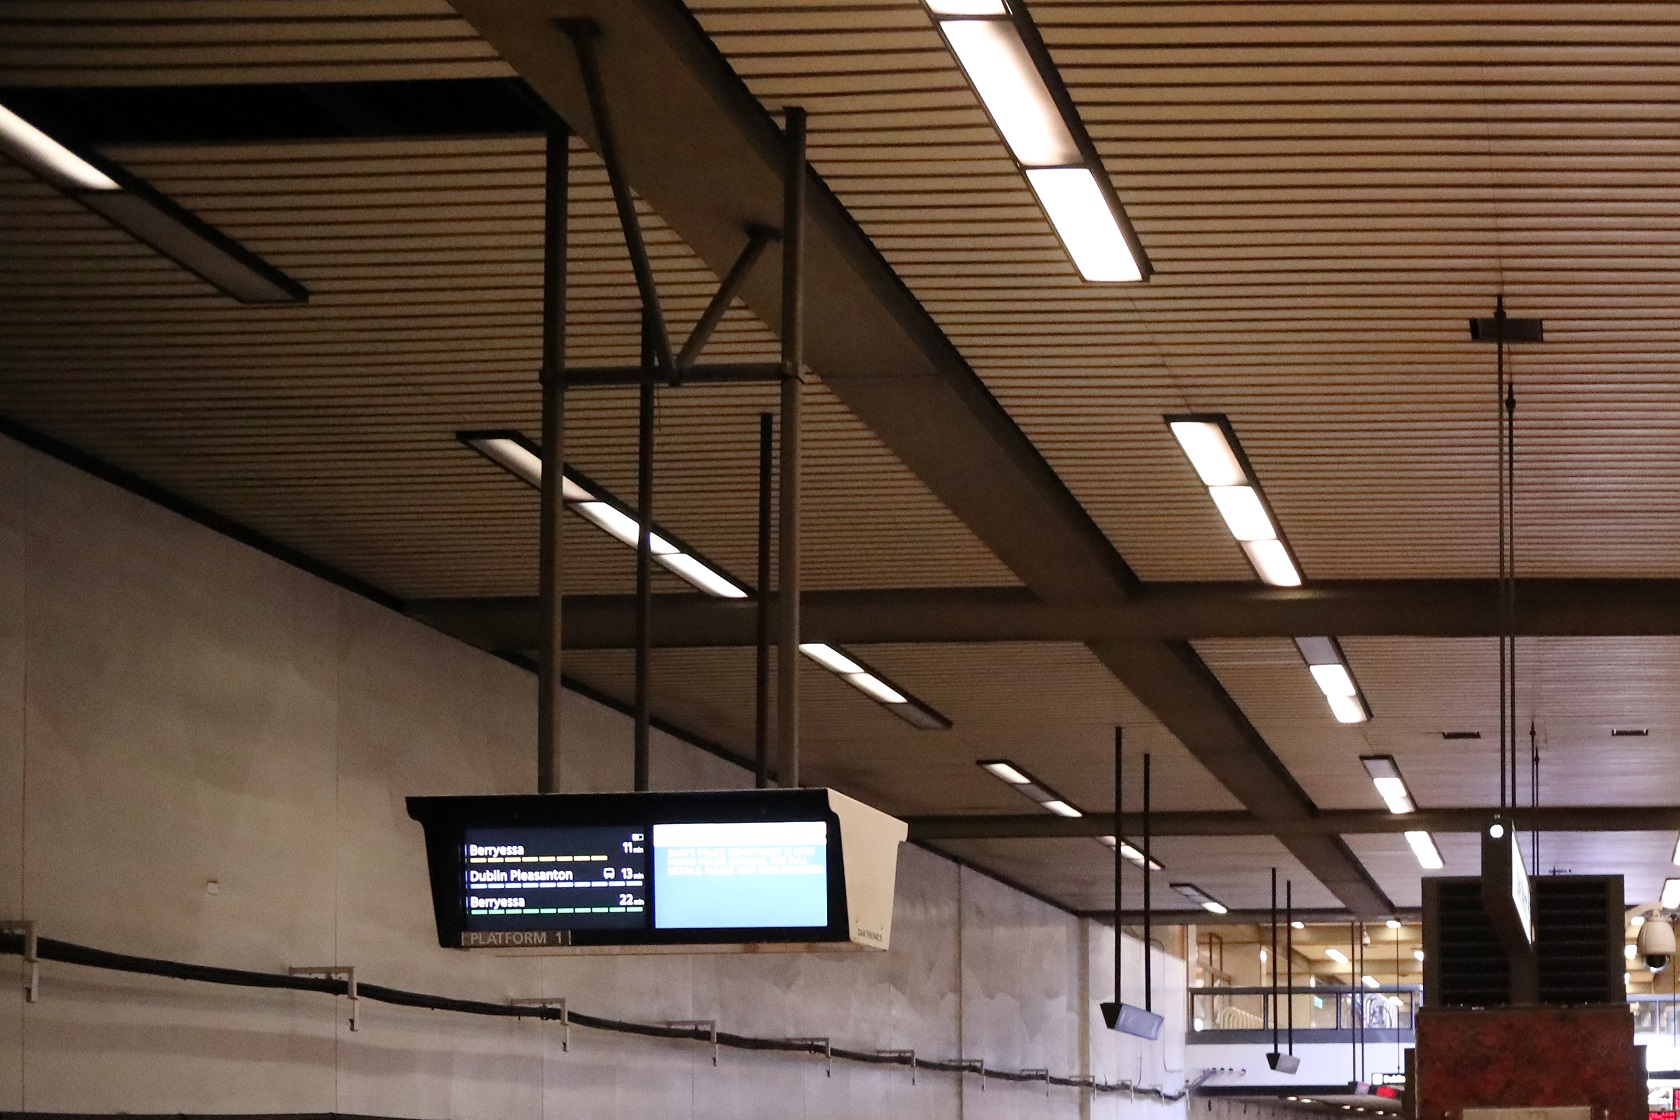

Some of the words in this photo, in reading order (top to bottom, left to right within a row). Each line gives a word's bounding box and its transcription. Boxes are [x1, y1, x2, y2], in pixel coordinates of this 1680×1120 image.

[469, 844, 524, 858] Berryessa
[470, 869, 508, 882] Dublin
[510, 869, 573, 882] Pleasanton
[470, 896, 526, 910] Berryessa
[619, 894, 633, 906] 22
[470, 932, 547, 945] PLATFORM
[555, 932, 562, 944] 1
